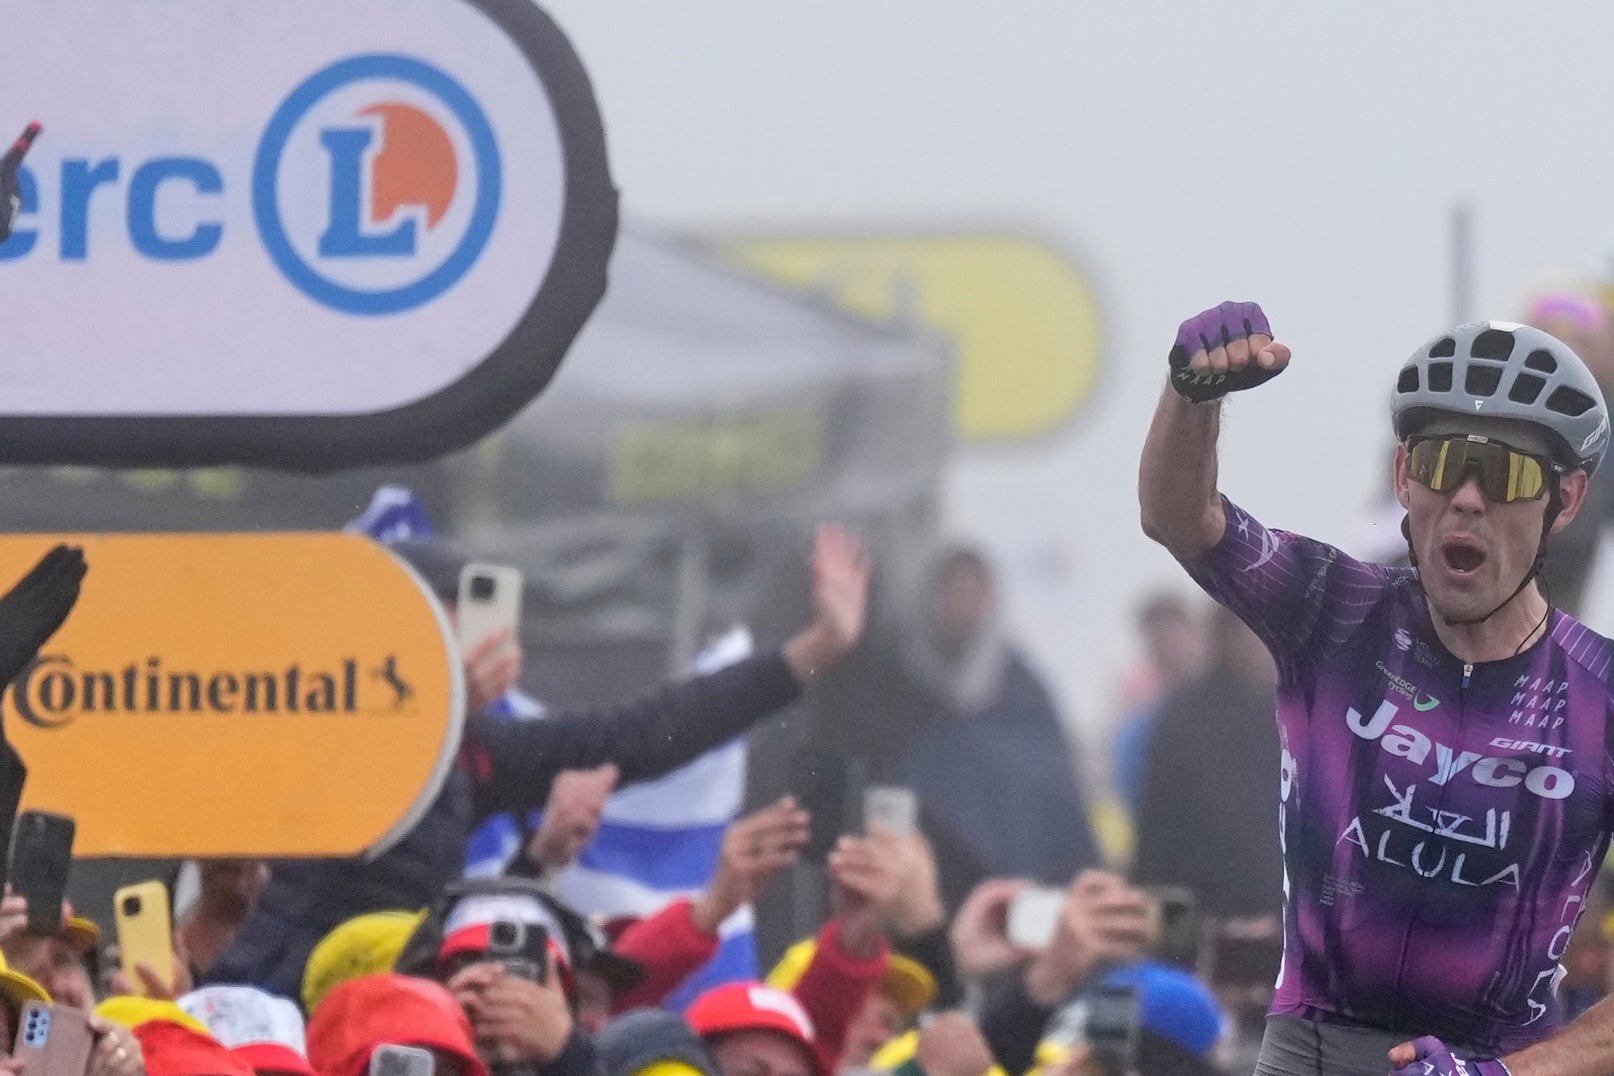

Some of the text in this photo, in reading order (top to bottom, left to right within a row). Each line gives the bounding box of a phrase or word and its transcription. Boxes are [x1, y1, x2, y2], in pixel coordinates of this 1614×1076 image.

[0, 154, 224, 262] rc
[13, 654, 358, 729] Continental
[1510, 692, 1566, 712] MAAP
[1513, 674, 1569, 694] MAAP
[1508, 710, 1564, 730] MAAP
[1345, 699, 1575, 800] Jayco
[1489, 737, 1574, 759] GIANT
[1336, 815, 1521, 893] ALULA
